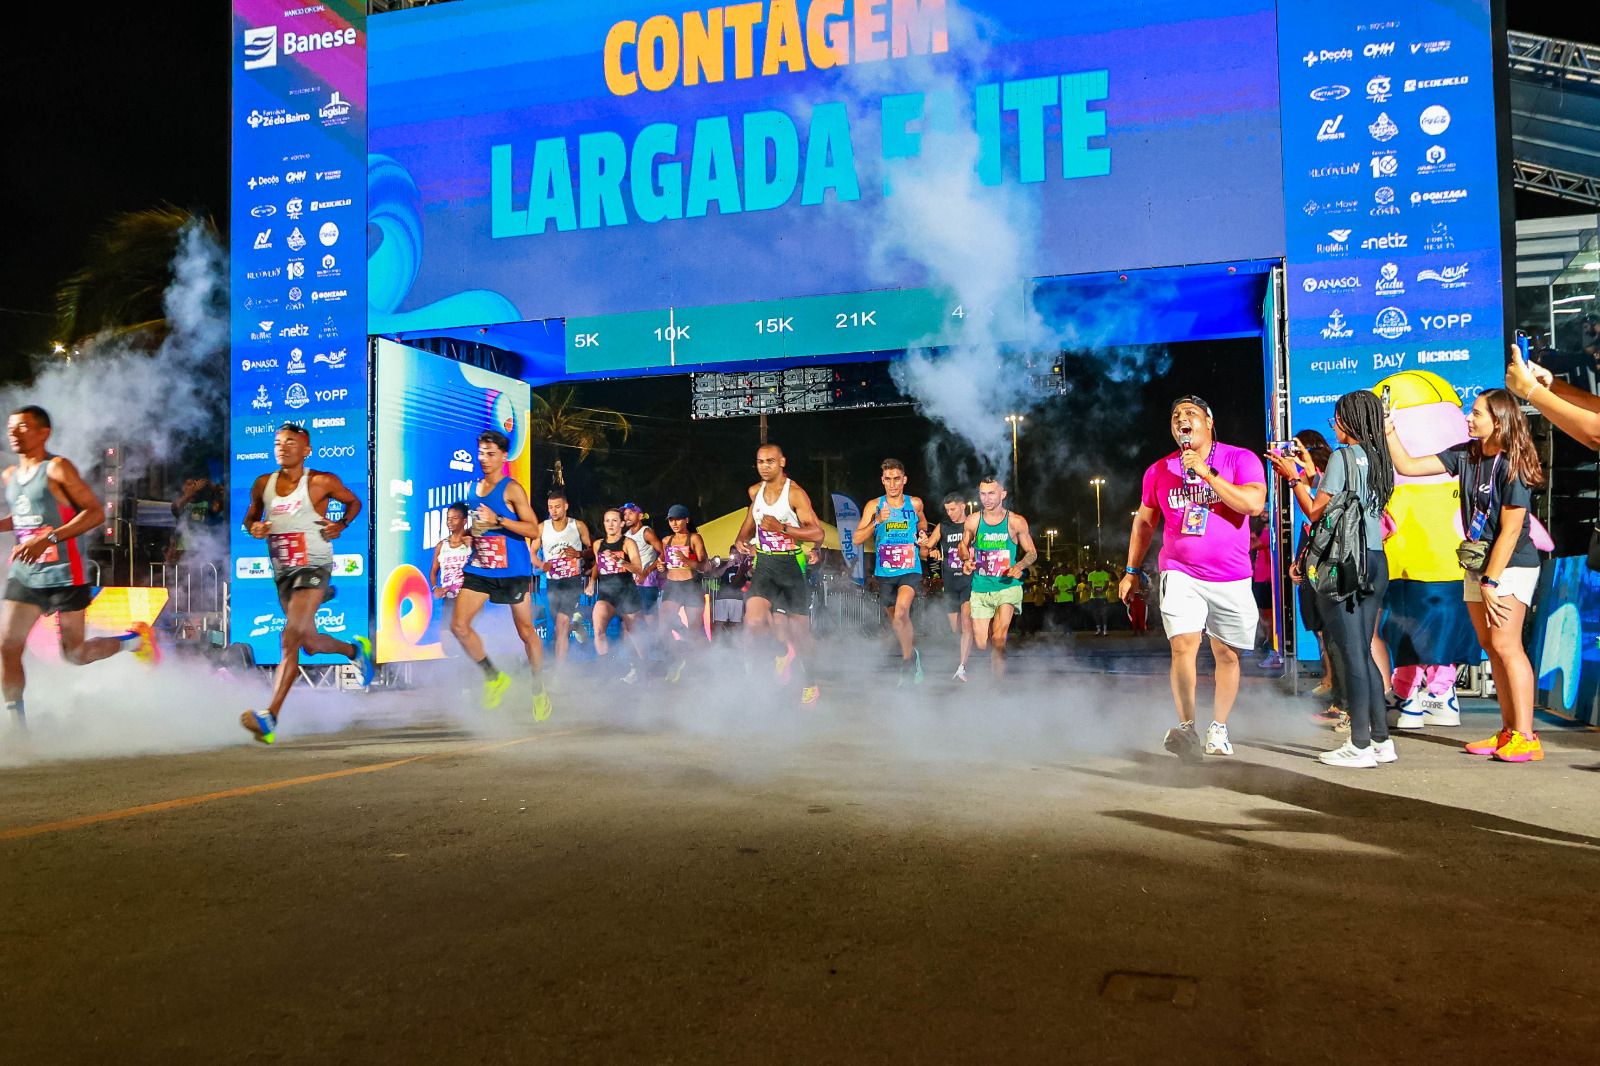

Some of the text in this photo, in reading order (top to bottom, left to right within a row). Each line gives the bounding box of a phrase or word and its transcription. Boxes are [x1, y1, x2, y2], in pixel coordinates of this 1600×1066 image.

[283, 27, 357, 55] Banese
[604, 0, 949, 96] CONTAGEM
[318, 105, 352, 119] Legislar
[273, 115, 286, 126] do
[491, 102, 861, 239] LARGADA
[1368, 232, 1408, 250] netiz
[1317, 276, 1362, 290] ANASOL
[1375, 277, 1404, 291] Kadu
[755, 317, 794, 335] 15K
[835, 310, 877, 329] 21K
[1420, 313, 1473, 330] YOPP
[575, 332, 600, 348] 5K
[653, 325, 690, 341] 10K
[251, 359, 279, 369] ANASOL
[1311, 357, 1359, 375] equaliv
[1373, 352, 1406, 370] BALY
[314, 388, 348, 402] YOPP
[1421, 700, 1444, 710] CORRE
